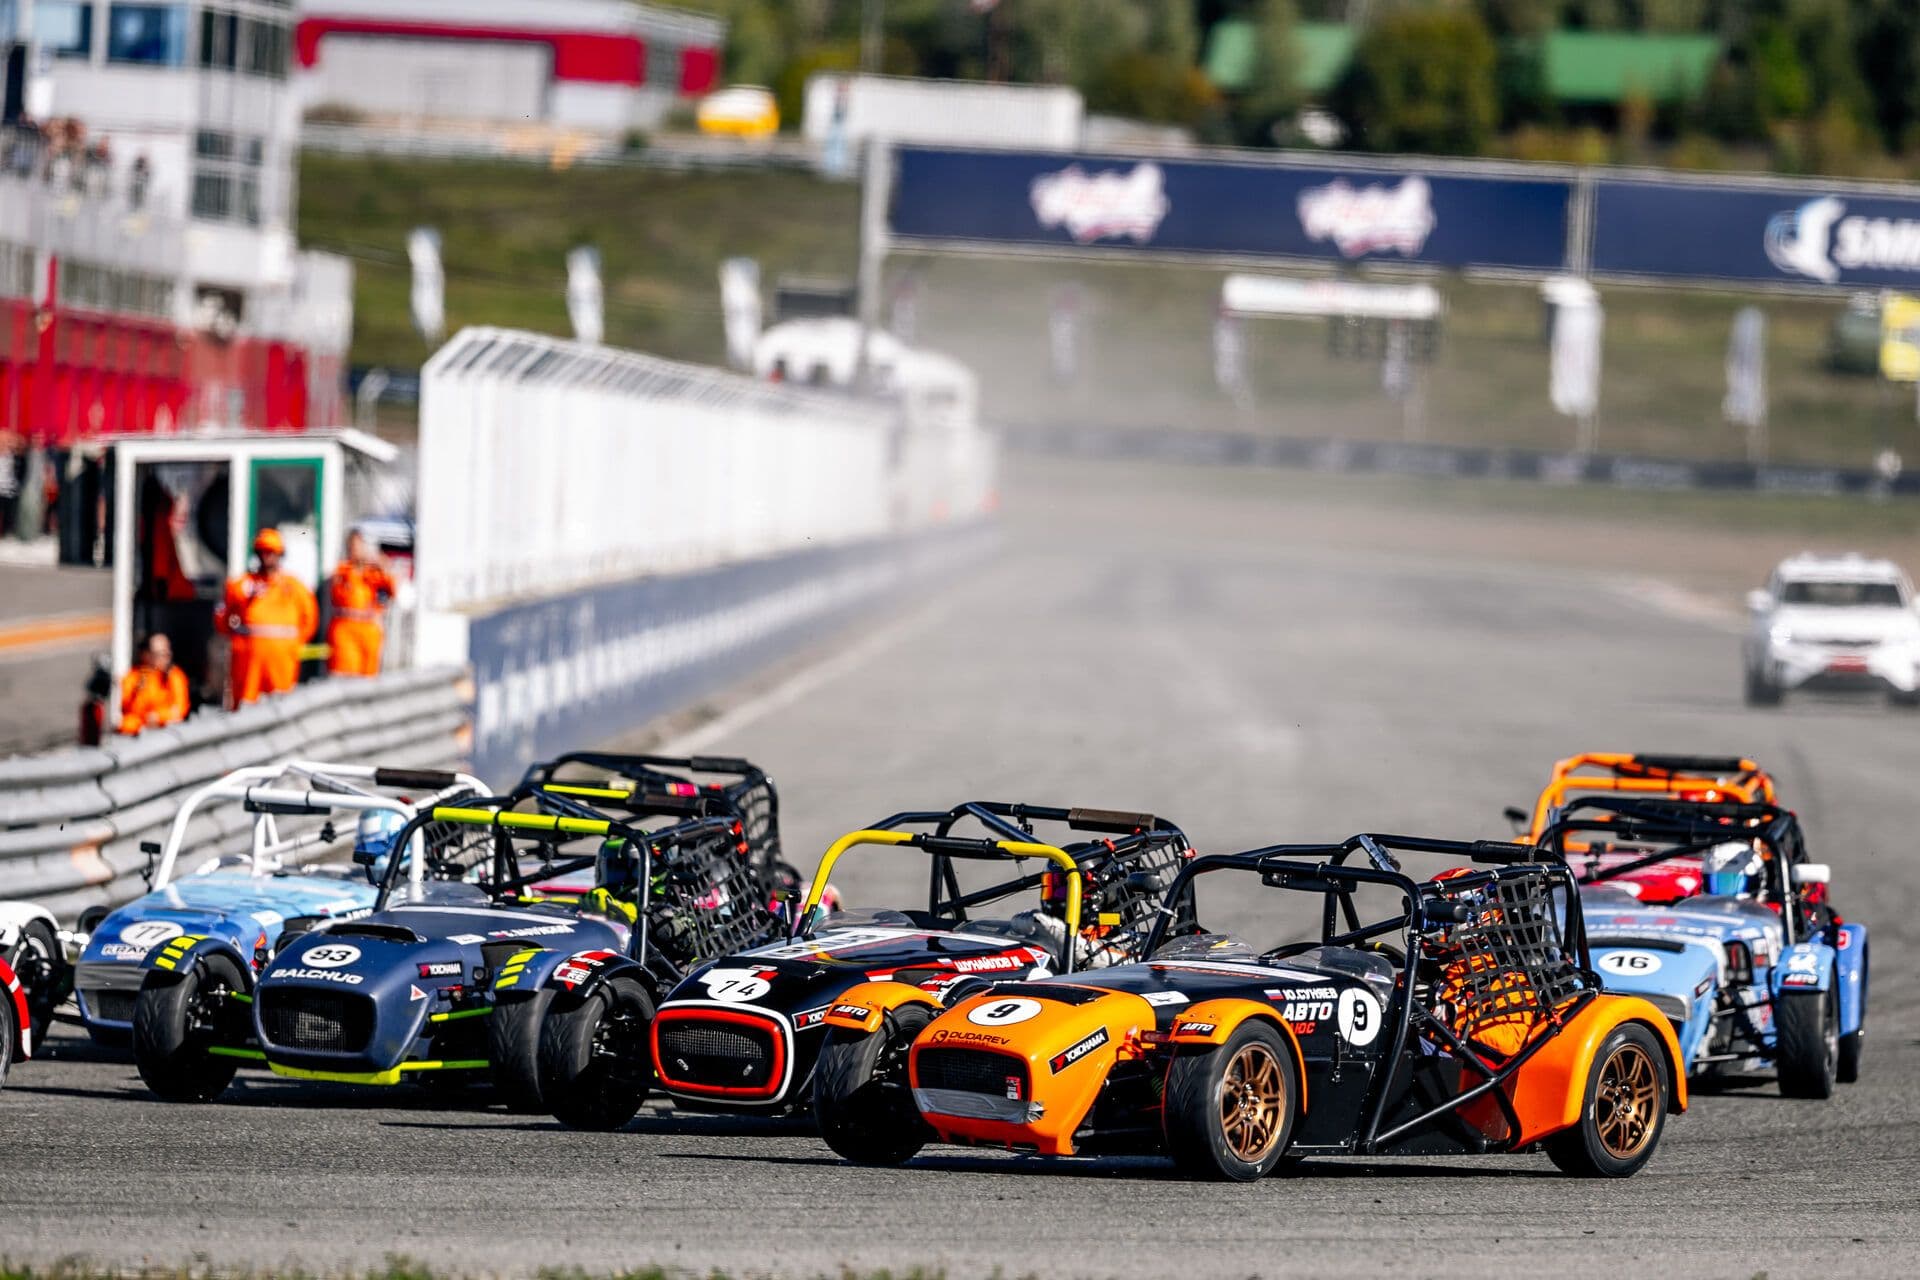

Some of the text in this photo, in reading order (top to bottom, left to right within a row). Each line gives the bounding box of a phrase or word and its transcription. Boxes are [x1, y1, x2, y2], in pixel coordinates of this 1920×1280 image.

[134, 926, 171, 939] 77
[310, 949, 352, 961] 93
[1608, 956, 1650, 969] 16
[270, 969, 364, 985] BALCHUG
[718, 980, 756, 996] 74
[987, 1004, 1021, 1018] 9
[1283, 1002, 1333, 1021] АВТО
[1354, 1000, 1368, 1031] 9
[1181, 1023, 1215, 1032] АВТО
[949, 1031, 1010, 1045] DUDAREV
[1065, 1032, 1106, 1062] YOKOHAMA
